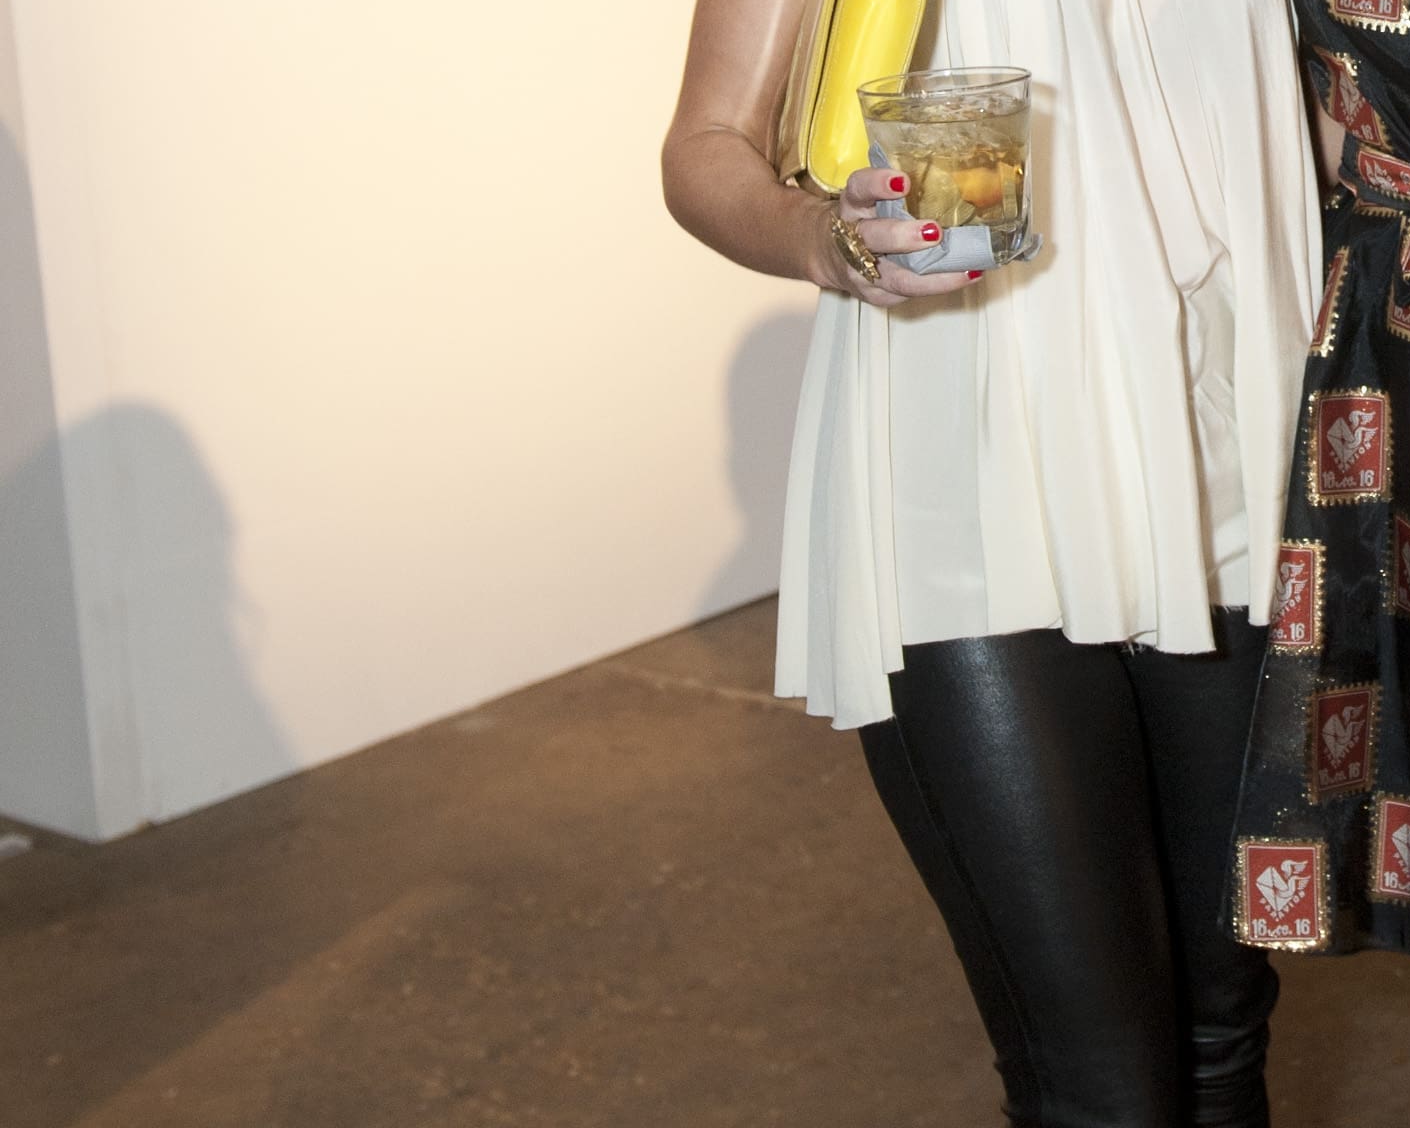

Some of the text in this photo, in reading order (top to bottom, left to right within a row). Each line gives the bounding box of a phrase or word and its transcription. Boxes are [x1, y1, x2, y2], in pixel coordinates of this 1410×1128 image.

[1359, 470, 1375, 487] 16
[1290, 623, 1305, 640] 16
[1384, 872, 1399, 888] 16
[1252, 918, 1267, 938] 16
[1294, 918, 1311, 935] 16
